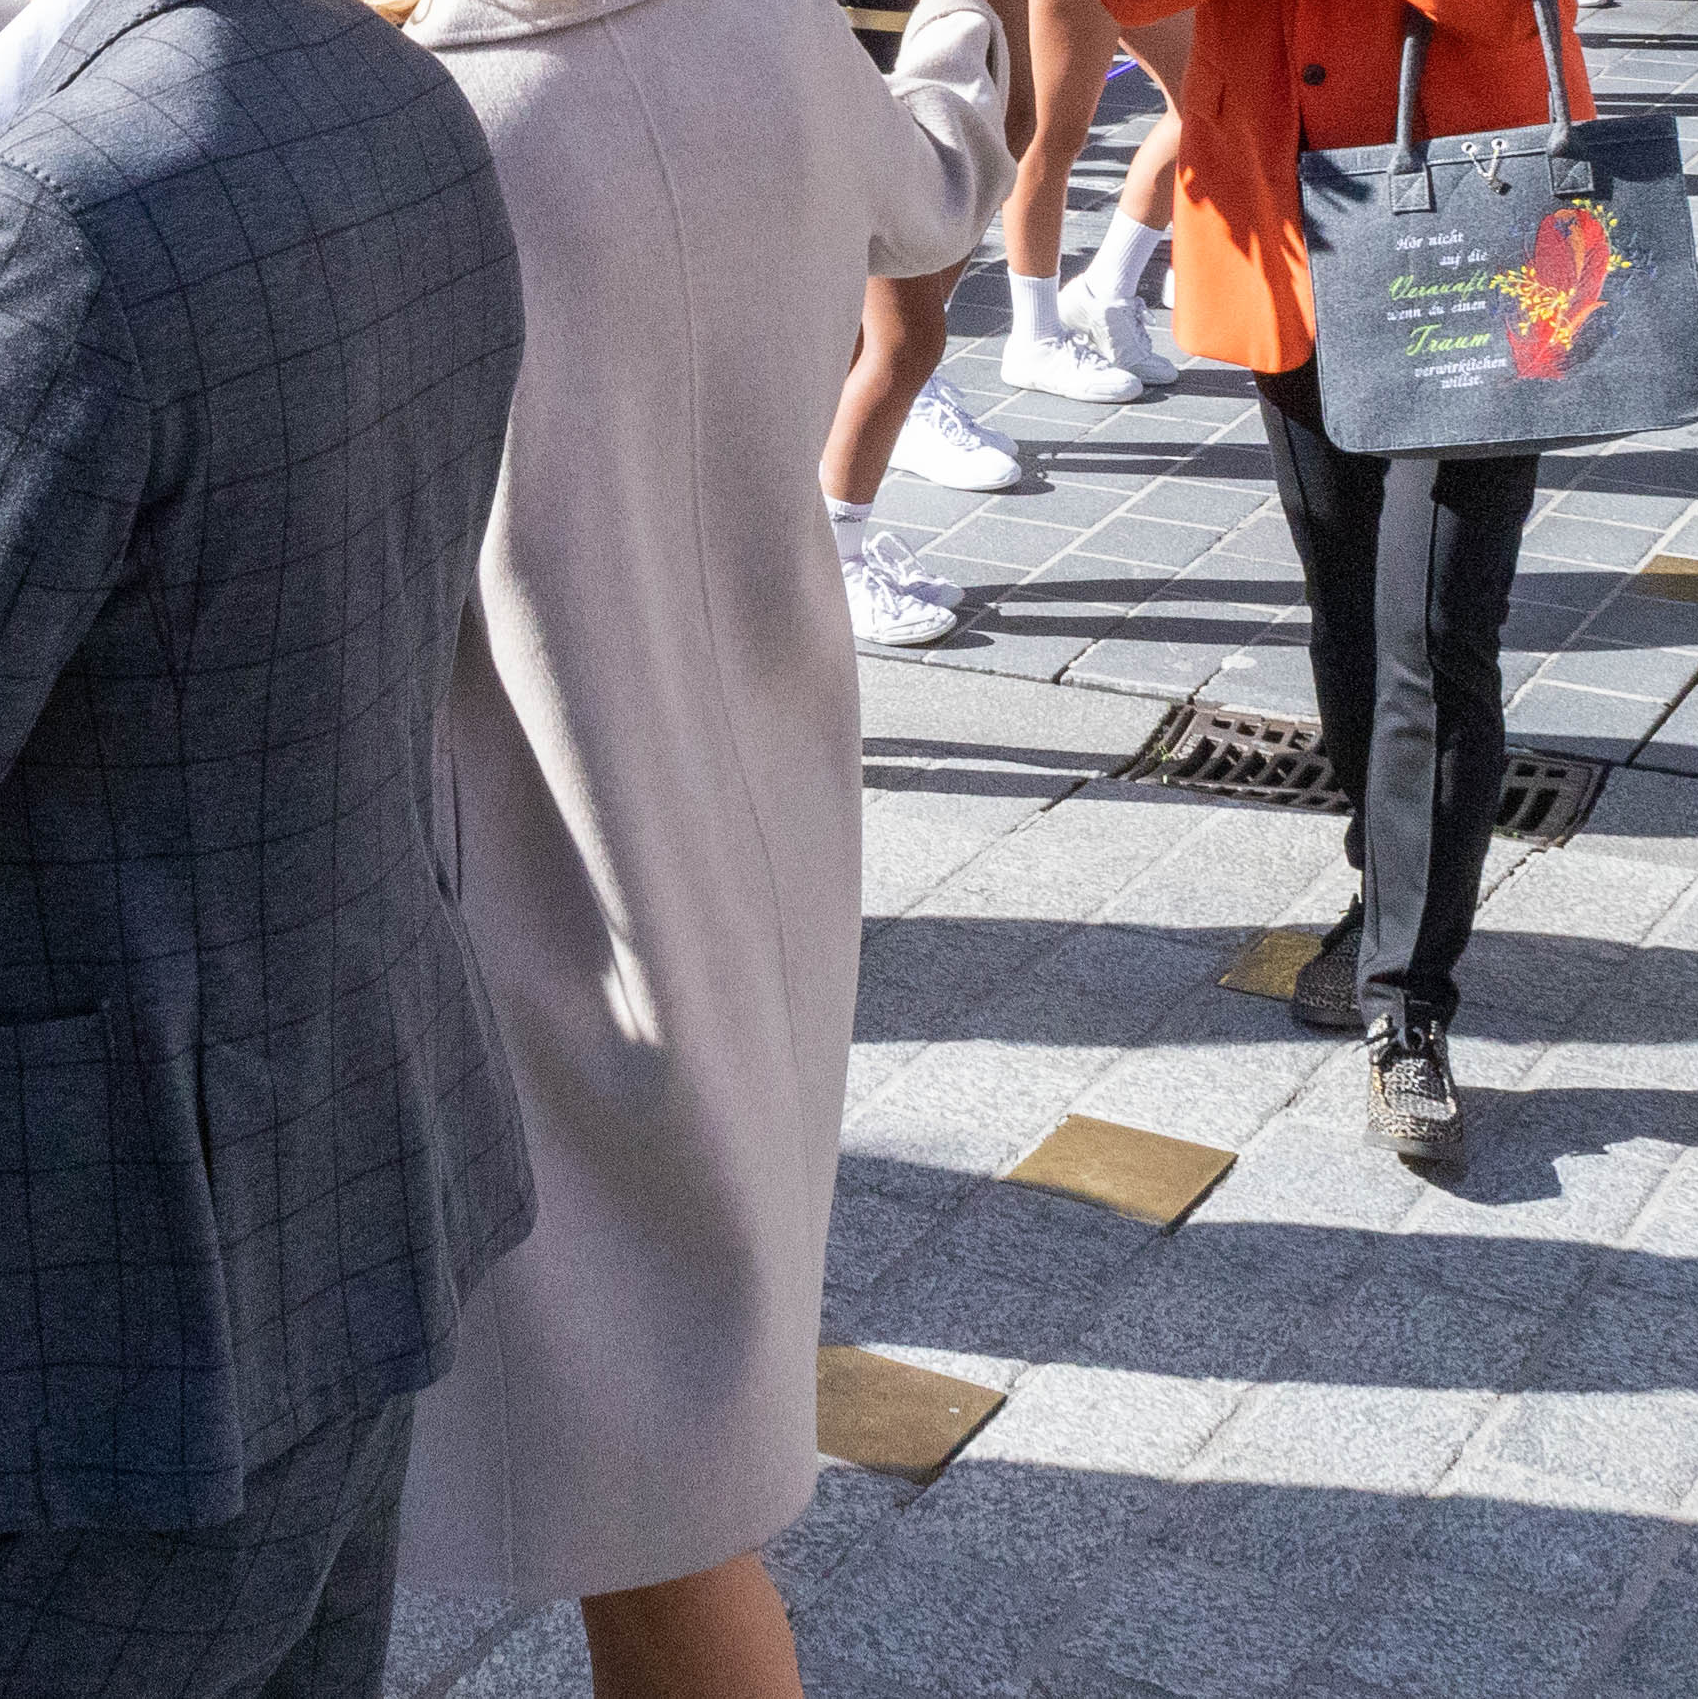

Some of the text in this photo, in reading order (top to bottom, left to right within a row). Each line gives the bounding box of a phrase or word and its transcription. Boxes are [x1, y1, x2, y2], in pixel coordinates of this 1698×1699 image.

[1428, 229, 1464, 247] nicht
[1467, 248, 1489, 263] die
[1389, 269, 1488, 302] Vernunft
[1387, 308, 1422, 321] wenn
[1451, 300, 1487, 314] einen
[1405, 323, 1491, 356] Traum
[1414, 356, 1508, 378] verwirklichen
